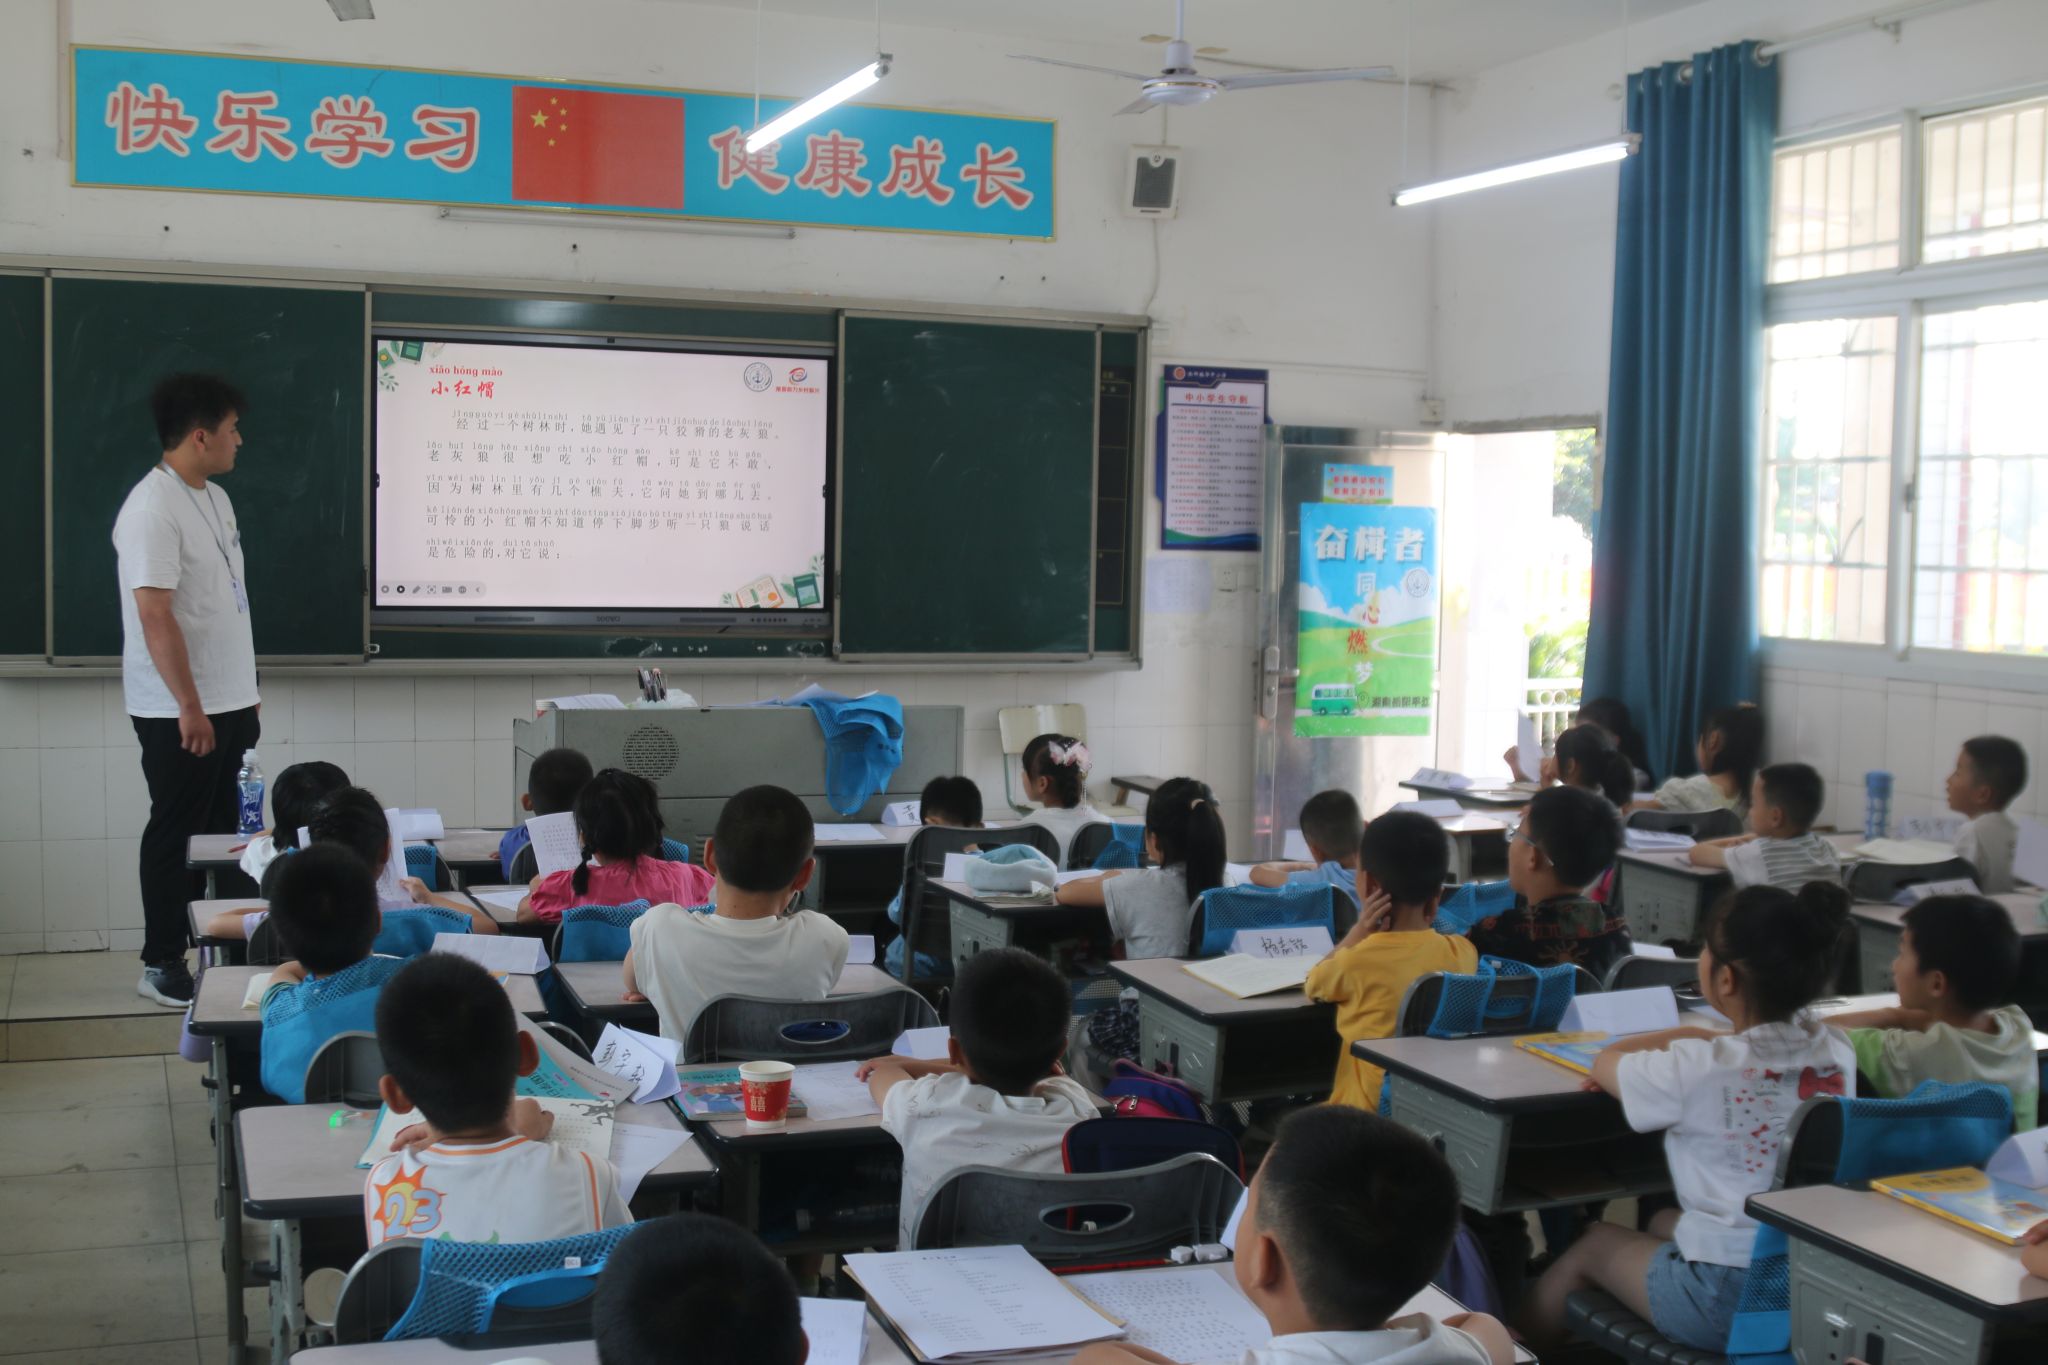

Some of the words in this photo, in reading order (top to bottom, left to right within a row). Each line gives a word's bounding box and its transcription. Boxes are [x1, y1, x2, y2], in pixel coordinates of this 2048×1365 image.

[105, 81, 480, 173] 快乐学习
[709, 125, 1034, 211] 健康成长
[431, 380, 495, 399] 小红帽
[1314, 524, 1426, 563] 奋楫者
[384, 1189, 443, 1238] 23
